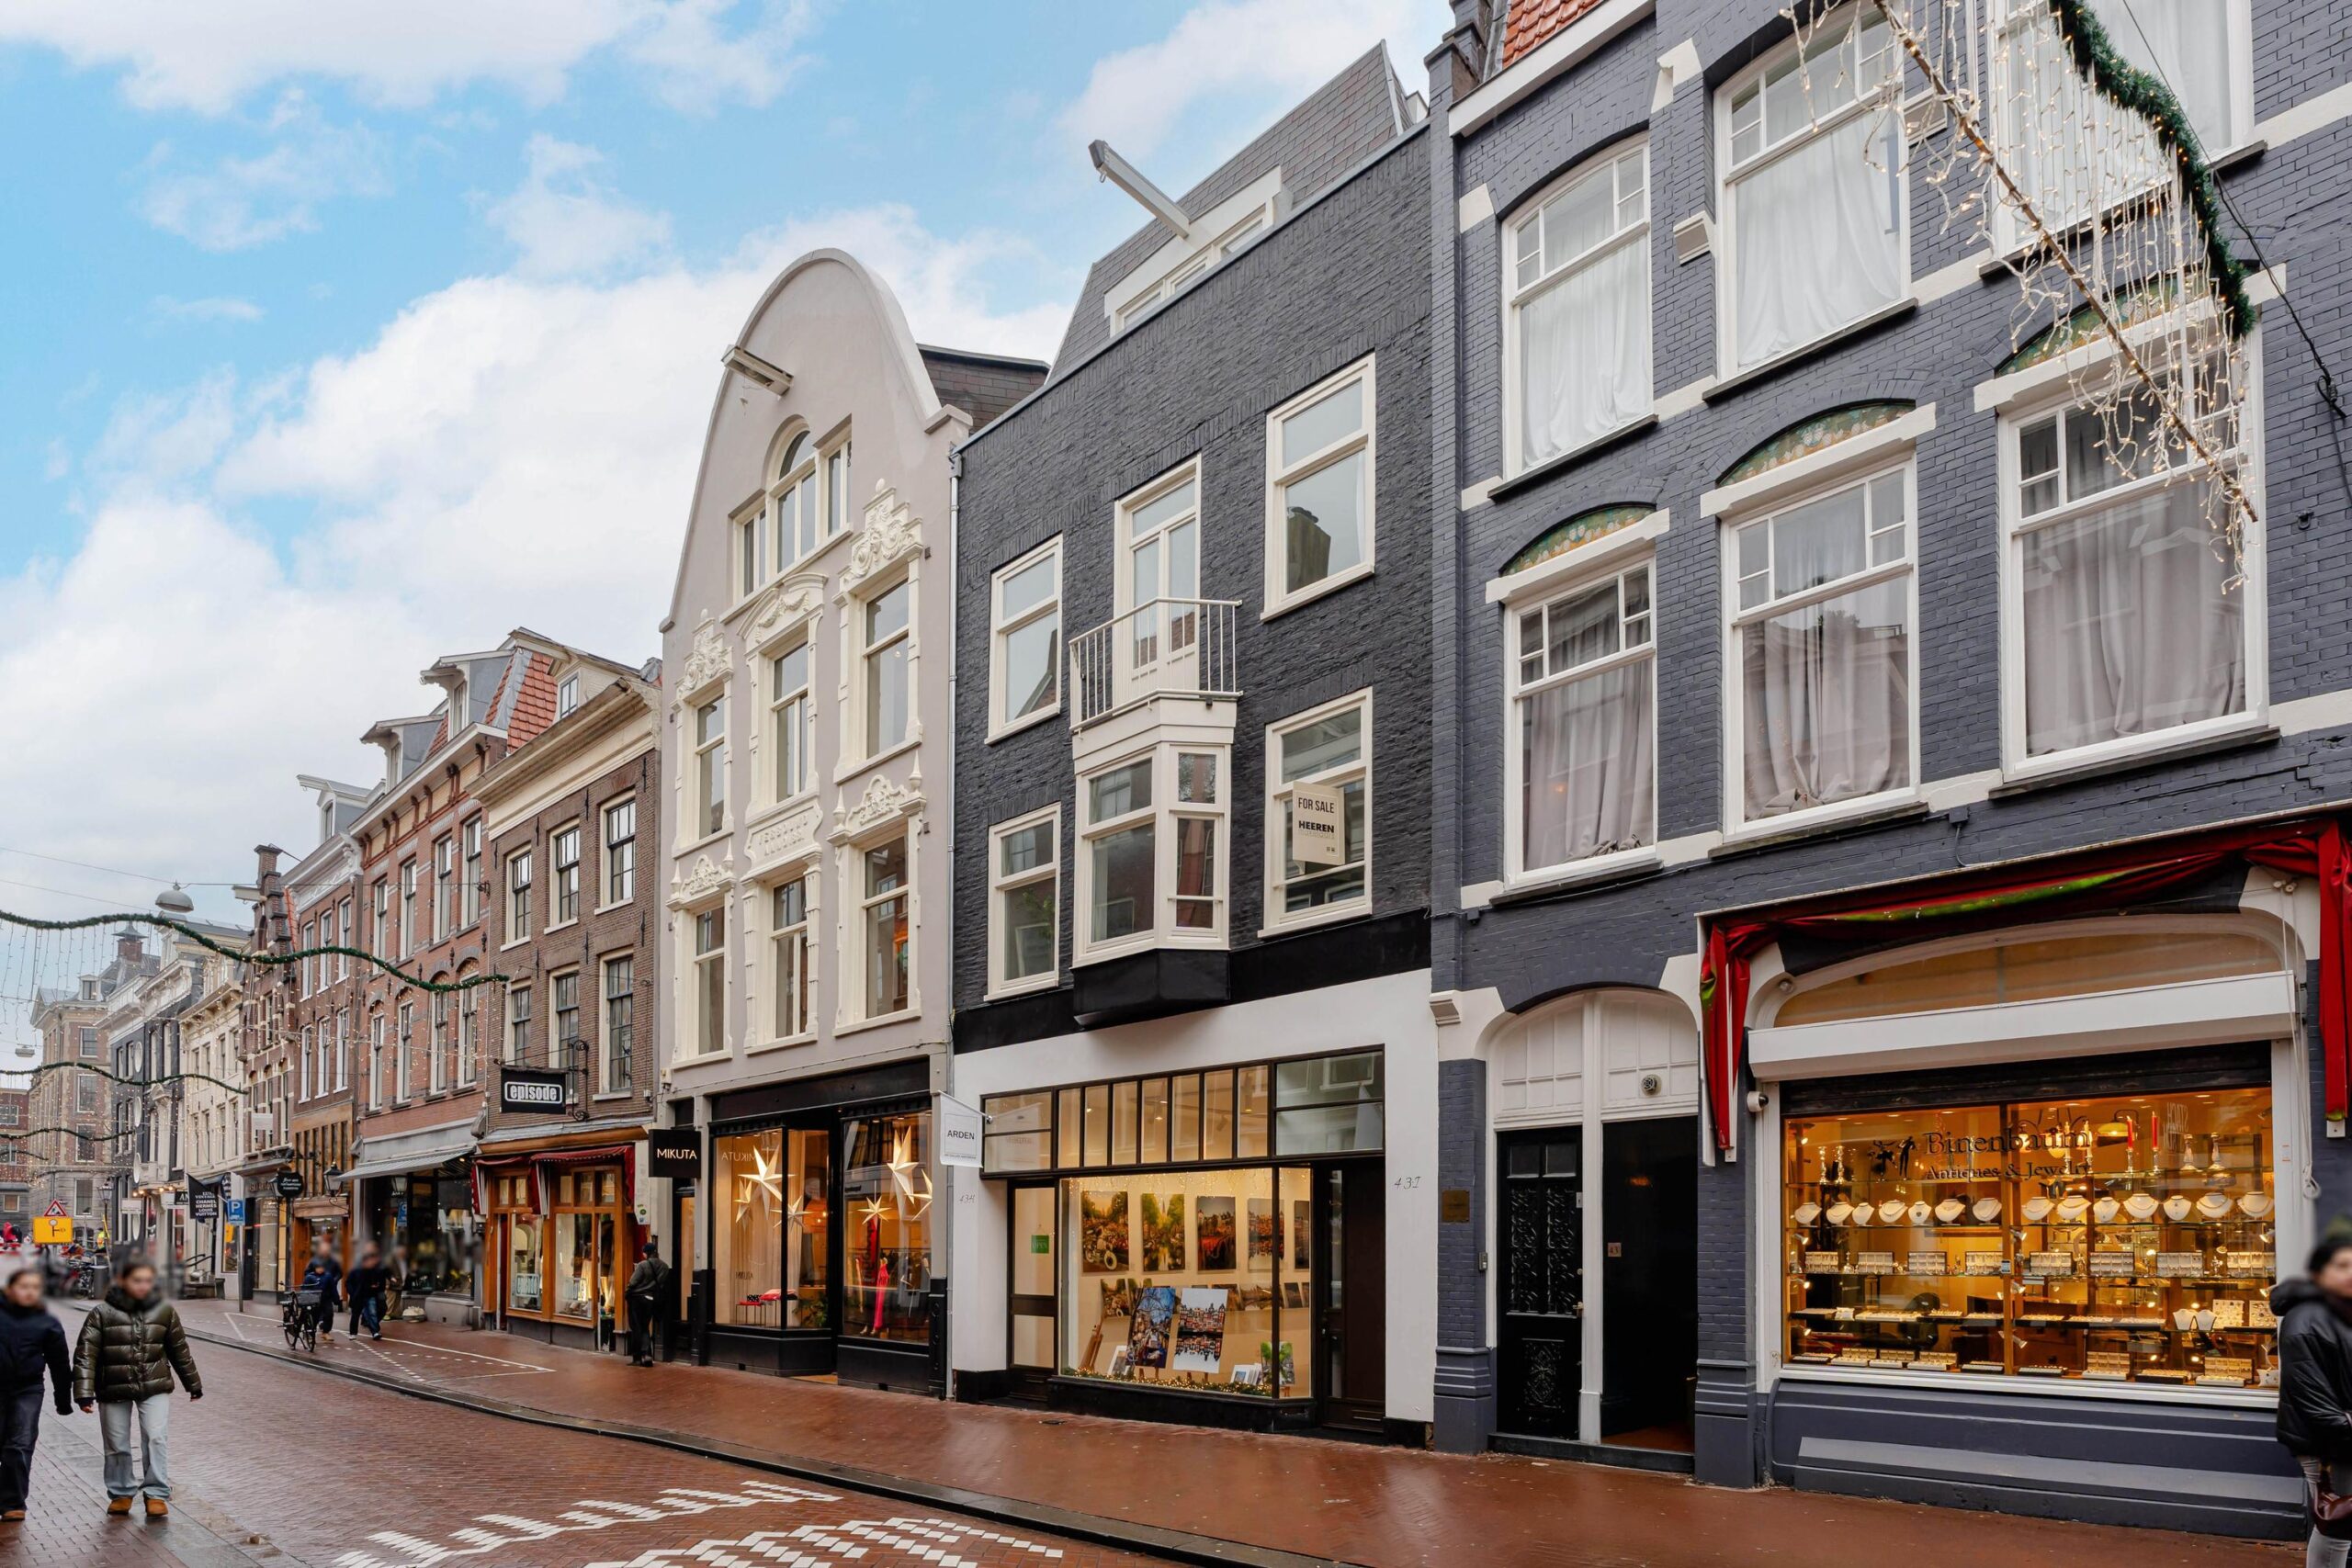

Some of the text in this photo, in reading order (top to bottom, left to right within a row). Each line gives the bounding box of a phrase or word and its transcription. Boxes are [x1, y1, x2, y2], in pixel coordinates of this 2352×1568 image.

[1298, 797, 1335, 814] FOR SALE
[1298, 820, 1335, 833] HEEREN
[510, 1084, 557, 1101] episode
[946, 1129, 975, 1140] ARDEN
[1923, 1126, 2091, 1155] Binenbaum
[657, 1148, 696, 1160] MIKUTA
[1926, 1160, 2093, 1183] Antiques & Jewelry
[232, 1201, 241, 1213] P
